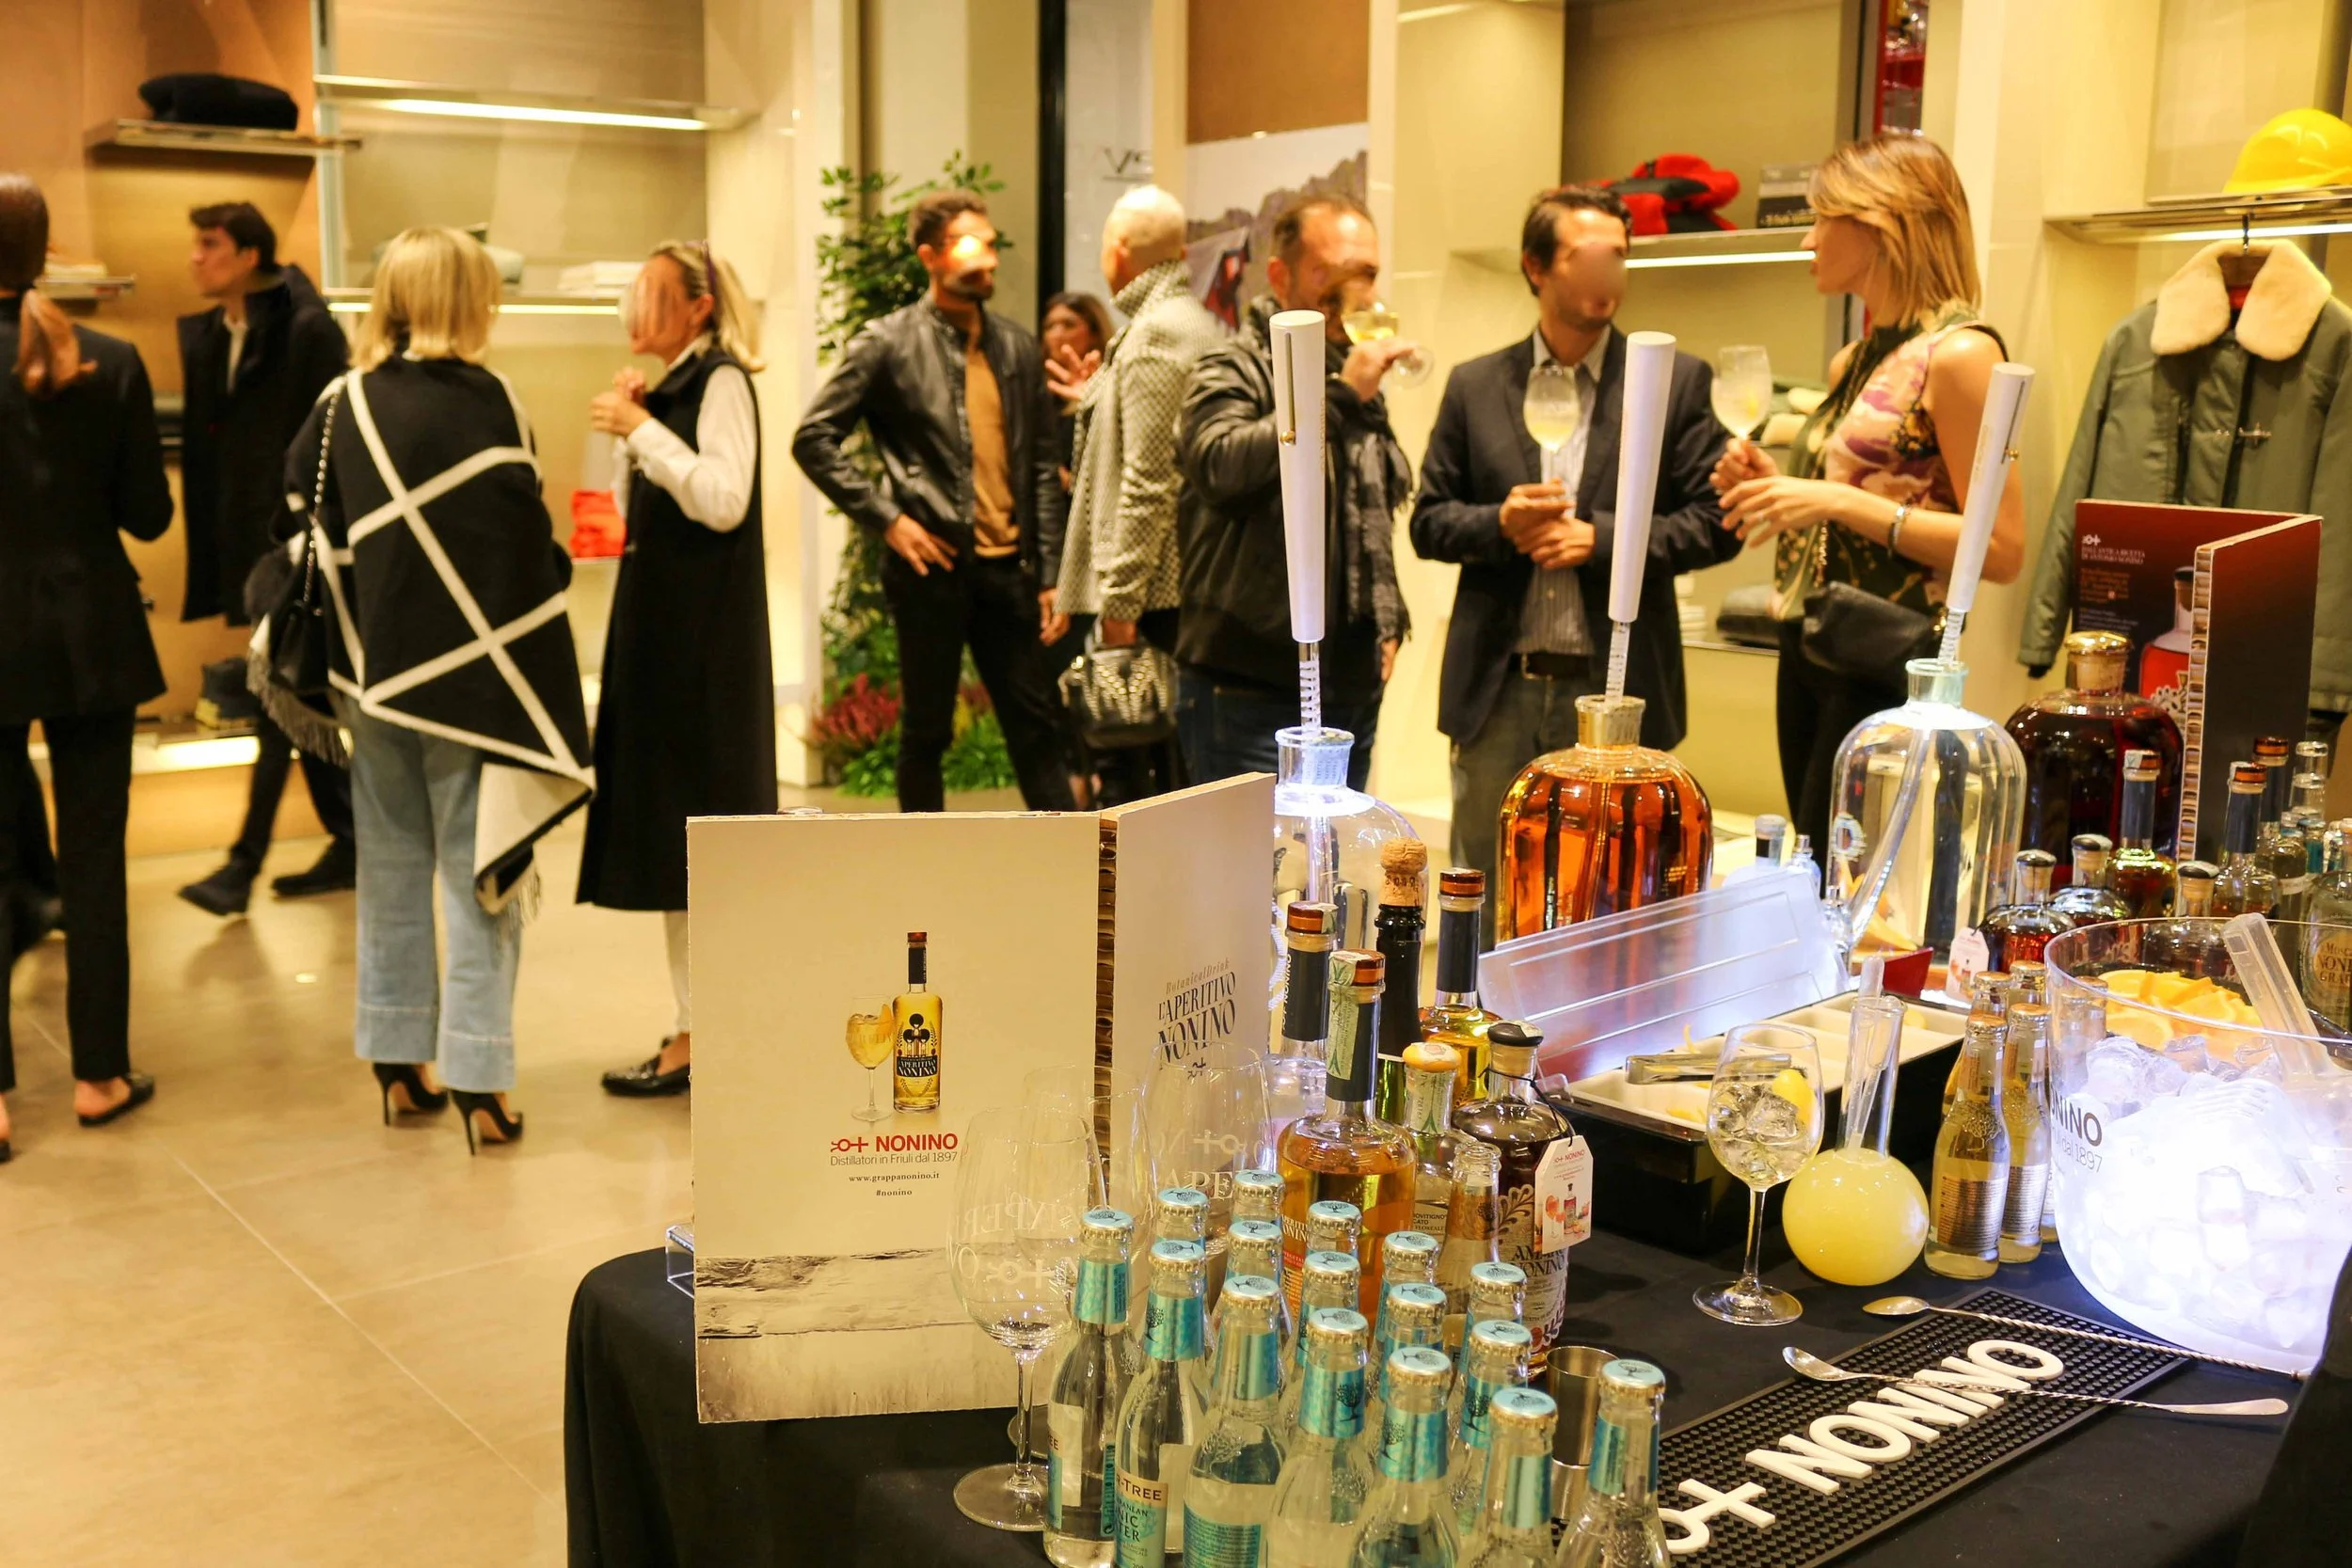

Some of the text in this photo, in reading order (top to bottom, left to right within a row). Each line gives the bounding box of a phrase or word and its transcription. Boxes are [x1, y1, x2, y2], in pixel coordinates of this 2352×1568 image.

[1158, 999, 1235, 1071] NONINO
[876, 1133, 959, 1152] NONINO
[831, 1151, 958, 1166] Distillatori in Friuli dal 1897
[2075, 1144, 2103, 1174] 1897
[849, 1172, 940, 1182] www.grappanonino.it
[1745, 1339, 2064, 1496] NONINO
